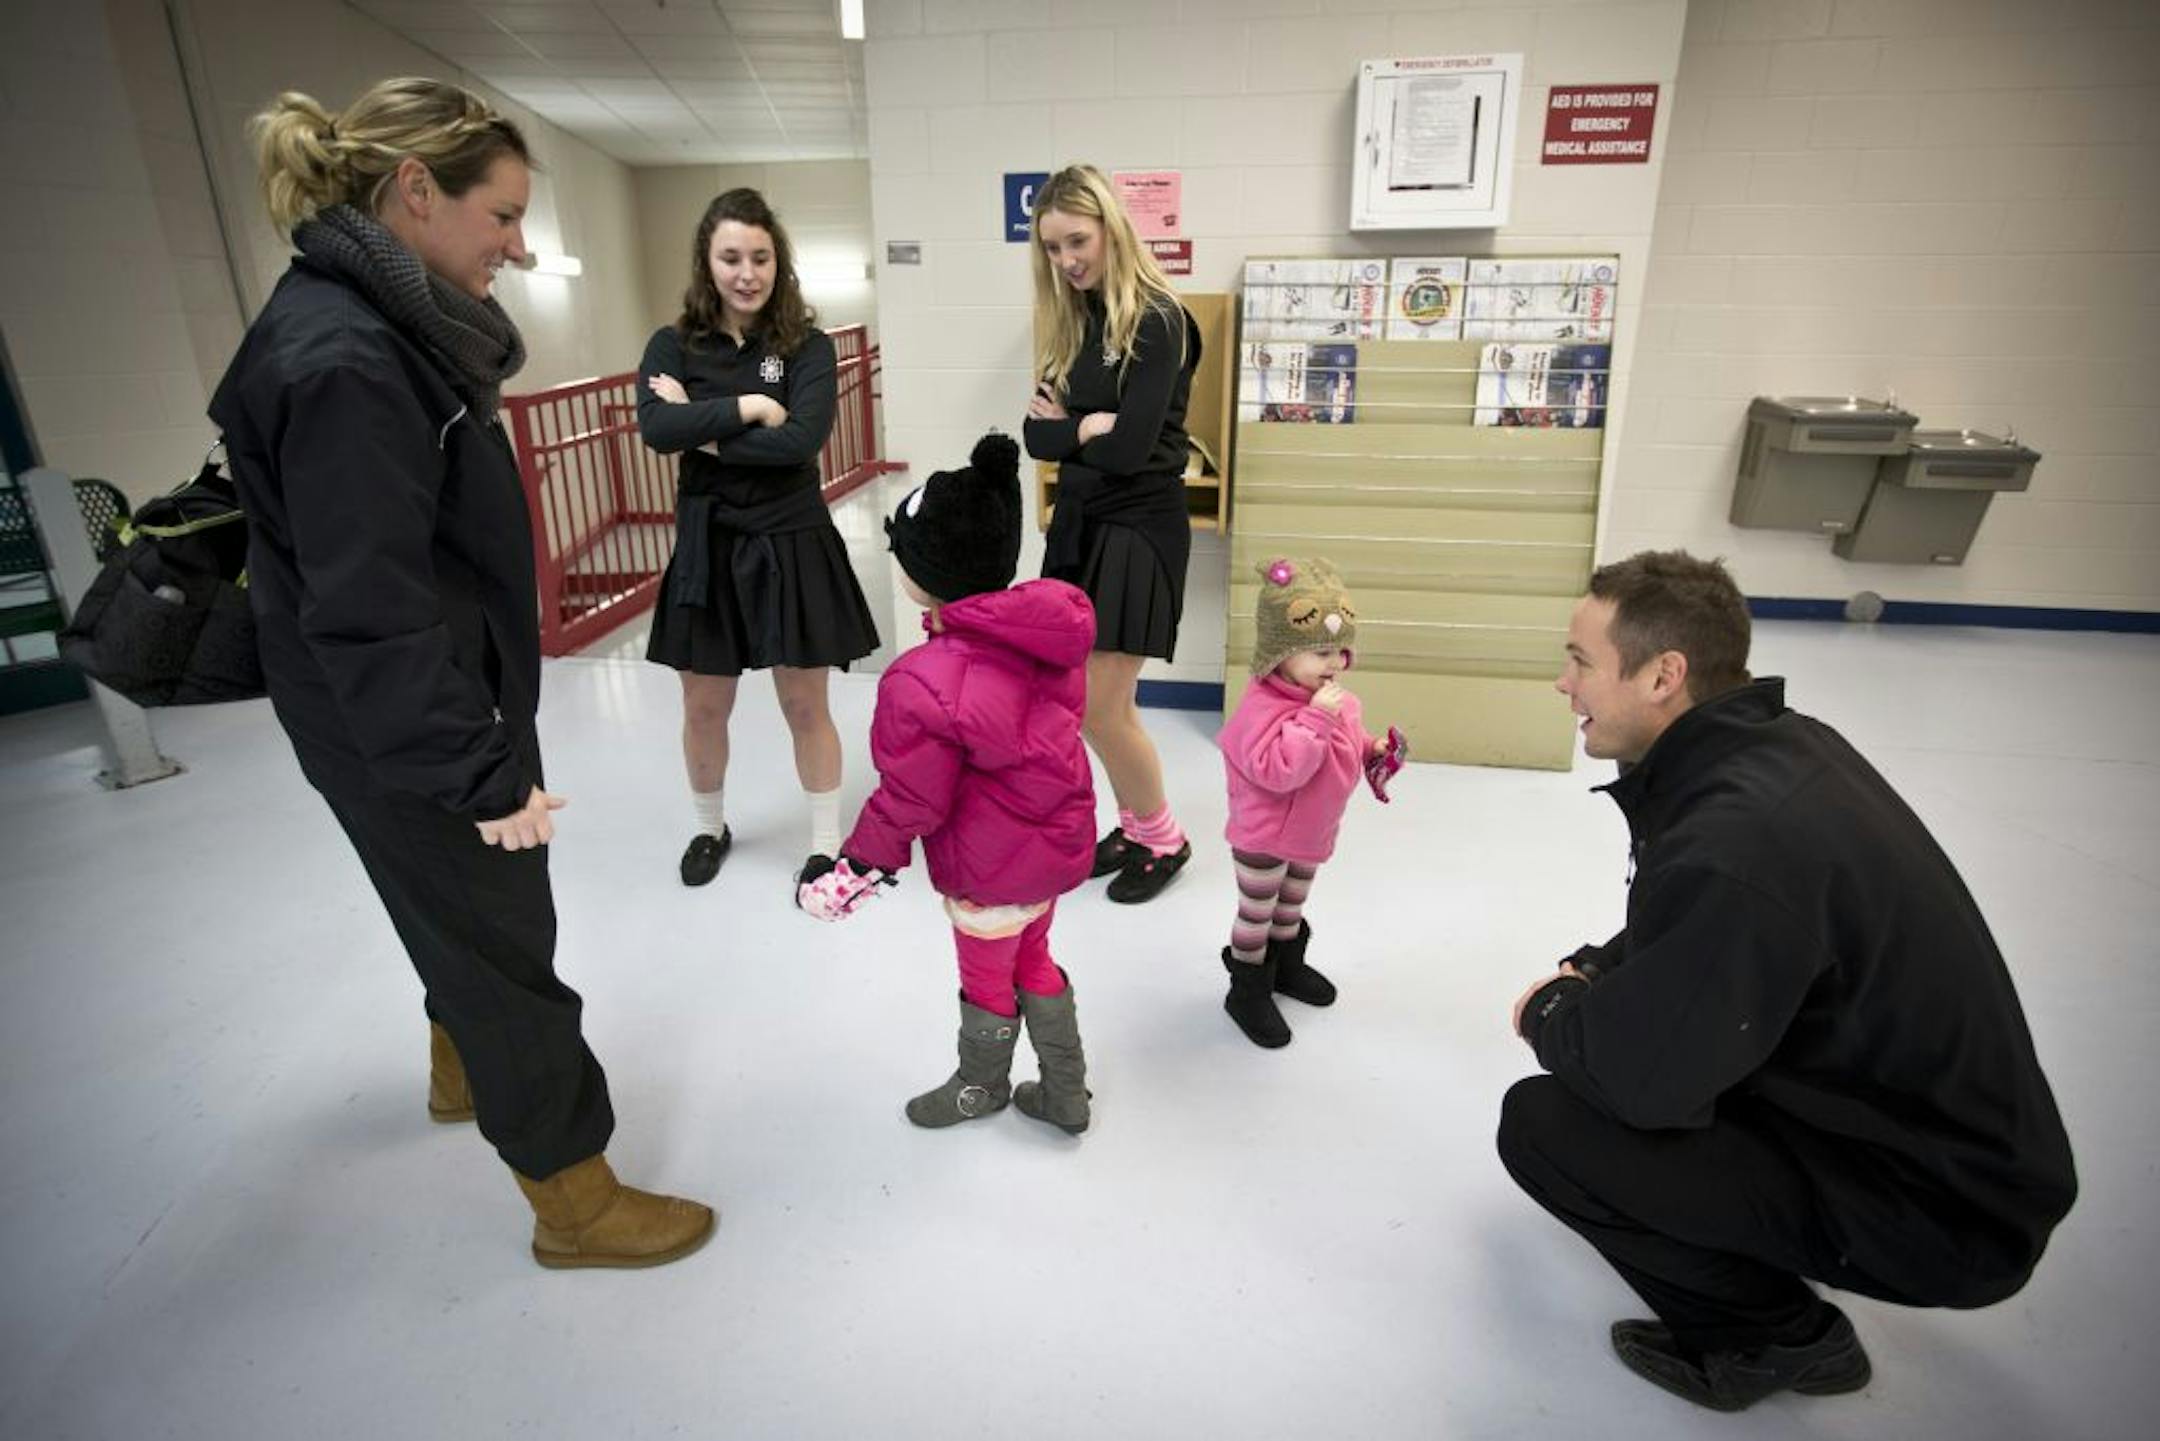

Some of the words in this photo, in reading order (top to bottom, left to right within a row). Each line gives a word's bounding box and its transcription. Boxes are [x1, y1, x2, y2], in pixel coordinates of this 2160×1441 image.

[1551, 94, 1572, 109] AED
[1572, 93, 1583, 108] IS
[1584, 92, 1632, 107] PROVIDED
[1633, 91, 1655, 107] FOR
[1570, 117, 1631, 132] EMERGENCY
[1545, 140, 1587, 155] MEDICAL
[1588, 140, 1648, 155] ASSISTANCE
